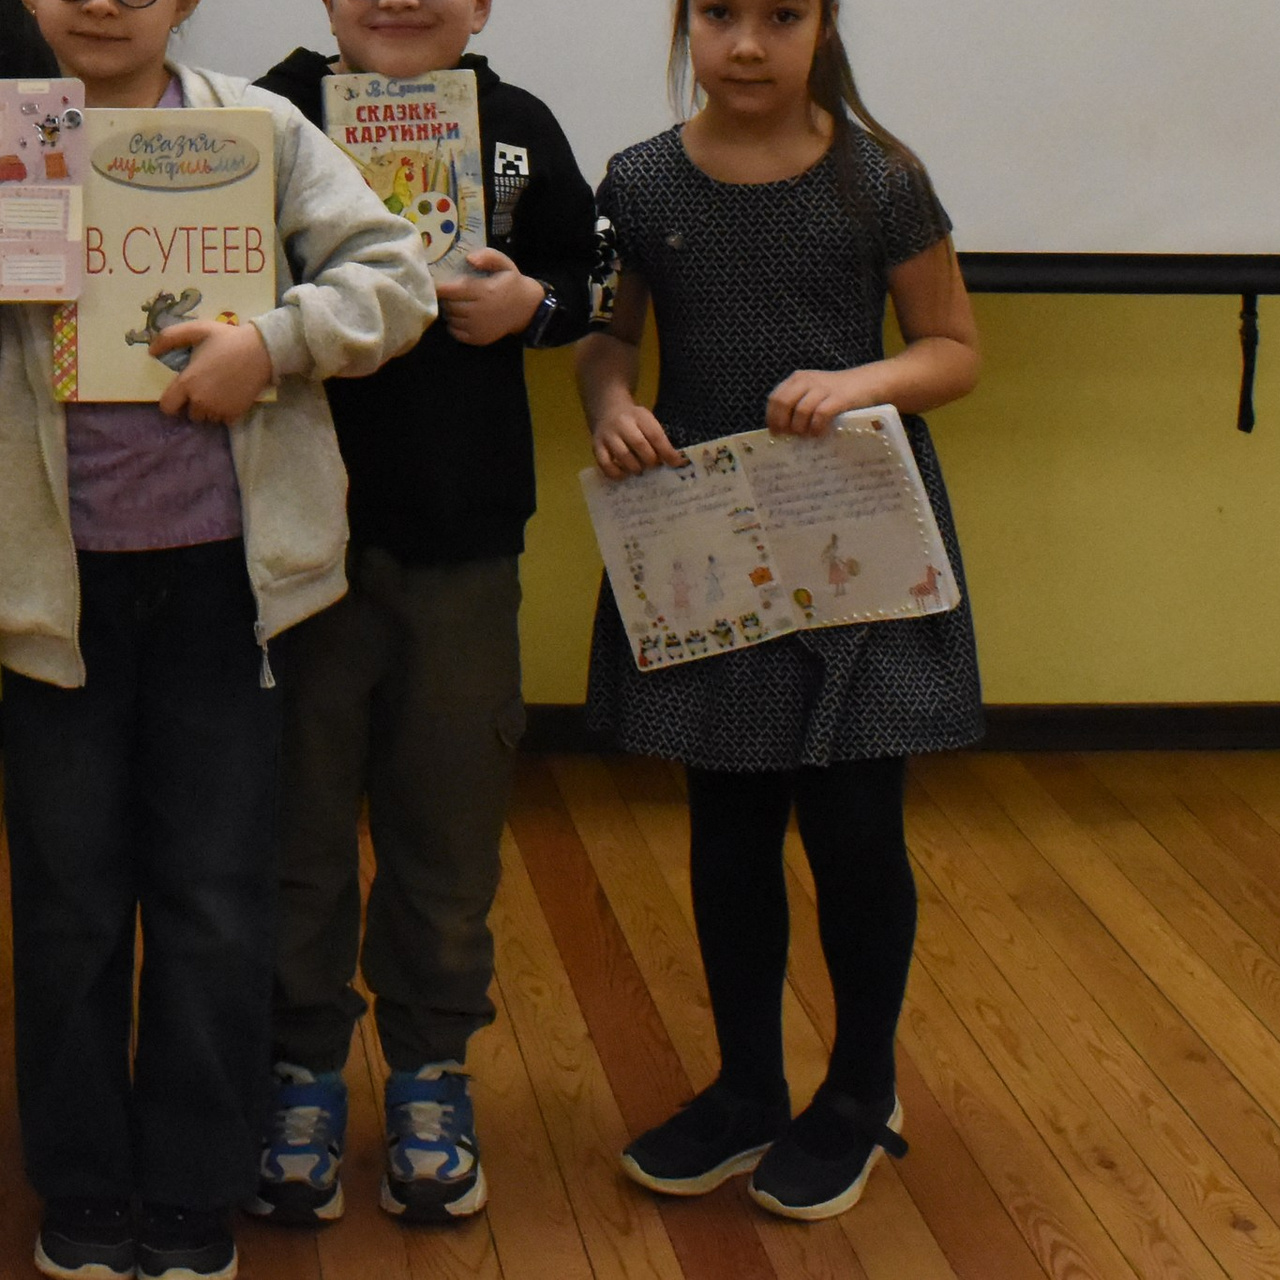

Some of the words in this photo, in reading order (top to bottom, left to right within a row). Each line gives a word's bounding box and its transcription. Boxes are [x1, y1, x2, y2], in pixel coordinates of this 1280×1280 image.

[356, 102, 447, 123] СКАЗКИ-
[345, 122, 461, 144] КАРТИНКИ
[85, 226, 114, 275] В.
[122, 226, 266, 275] СУТЕЕВ
